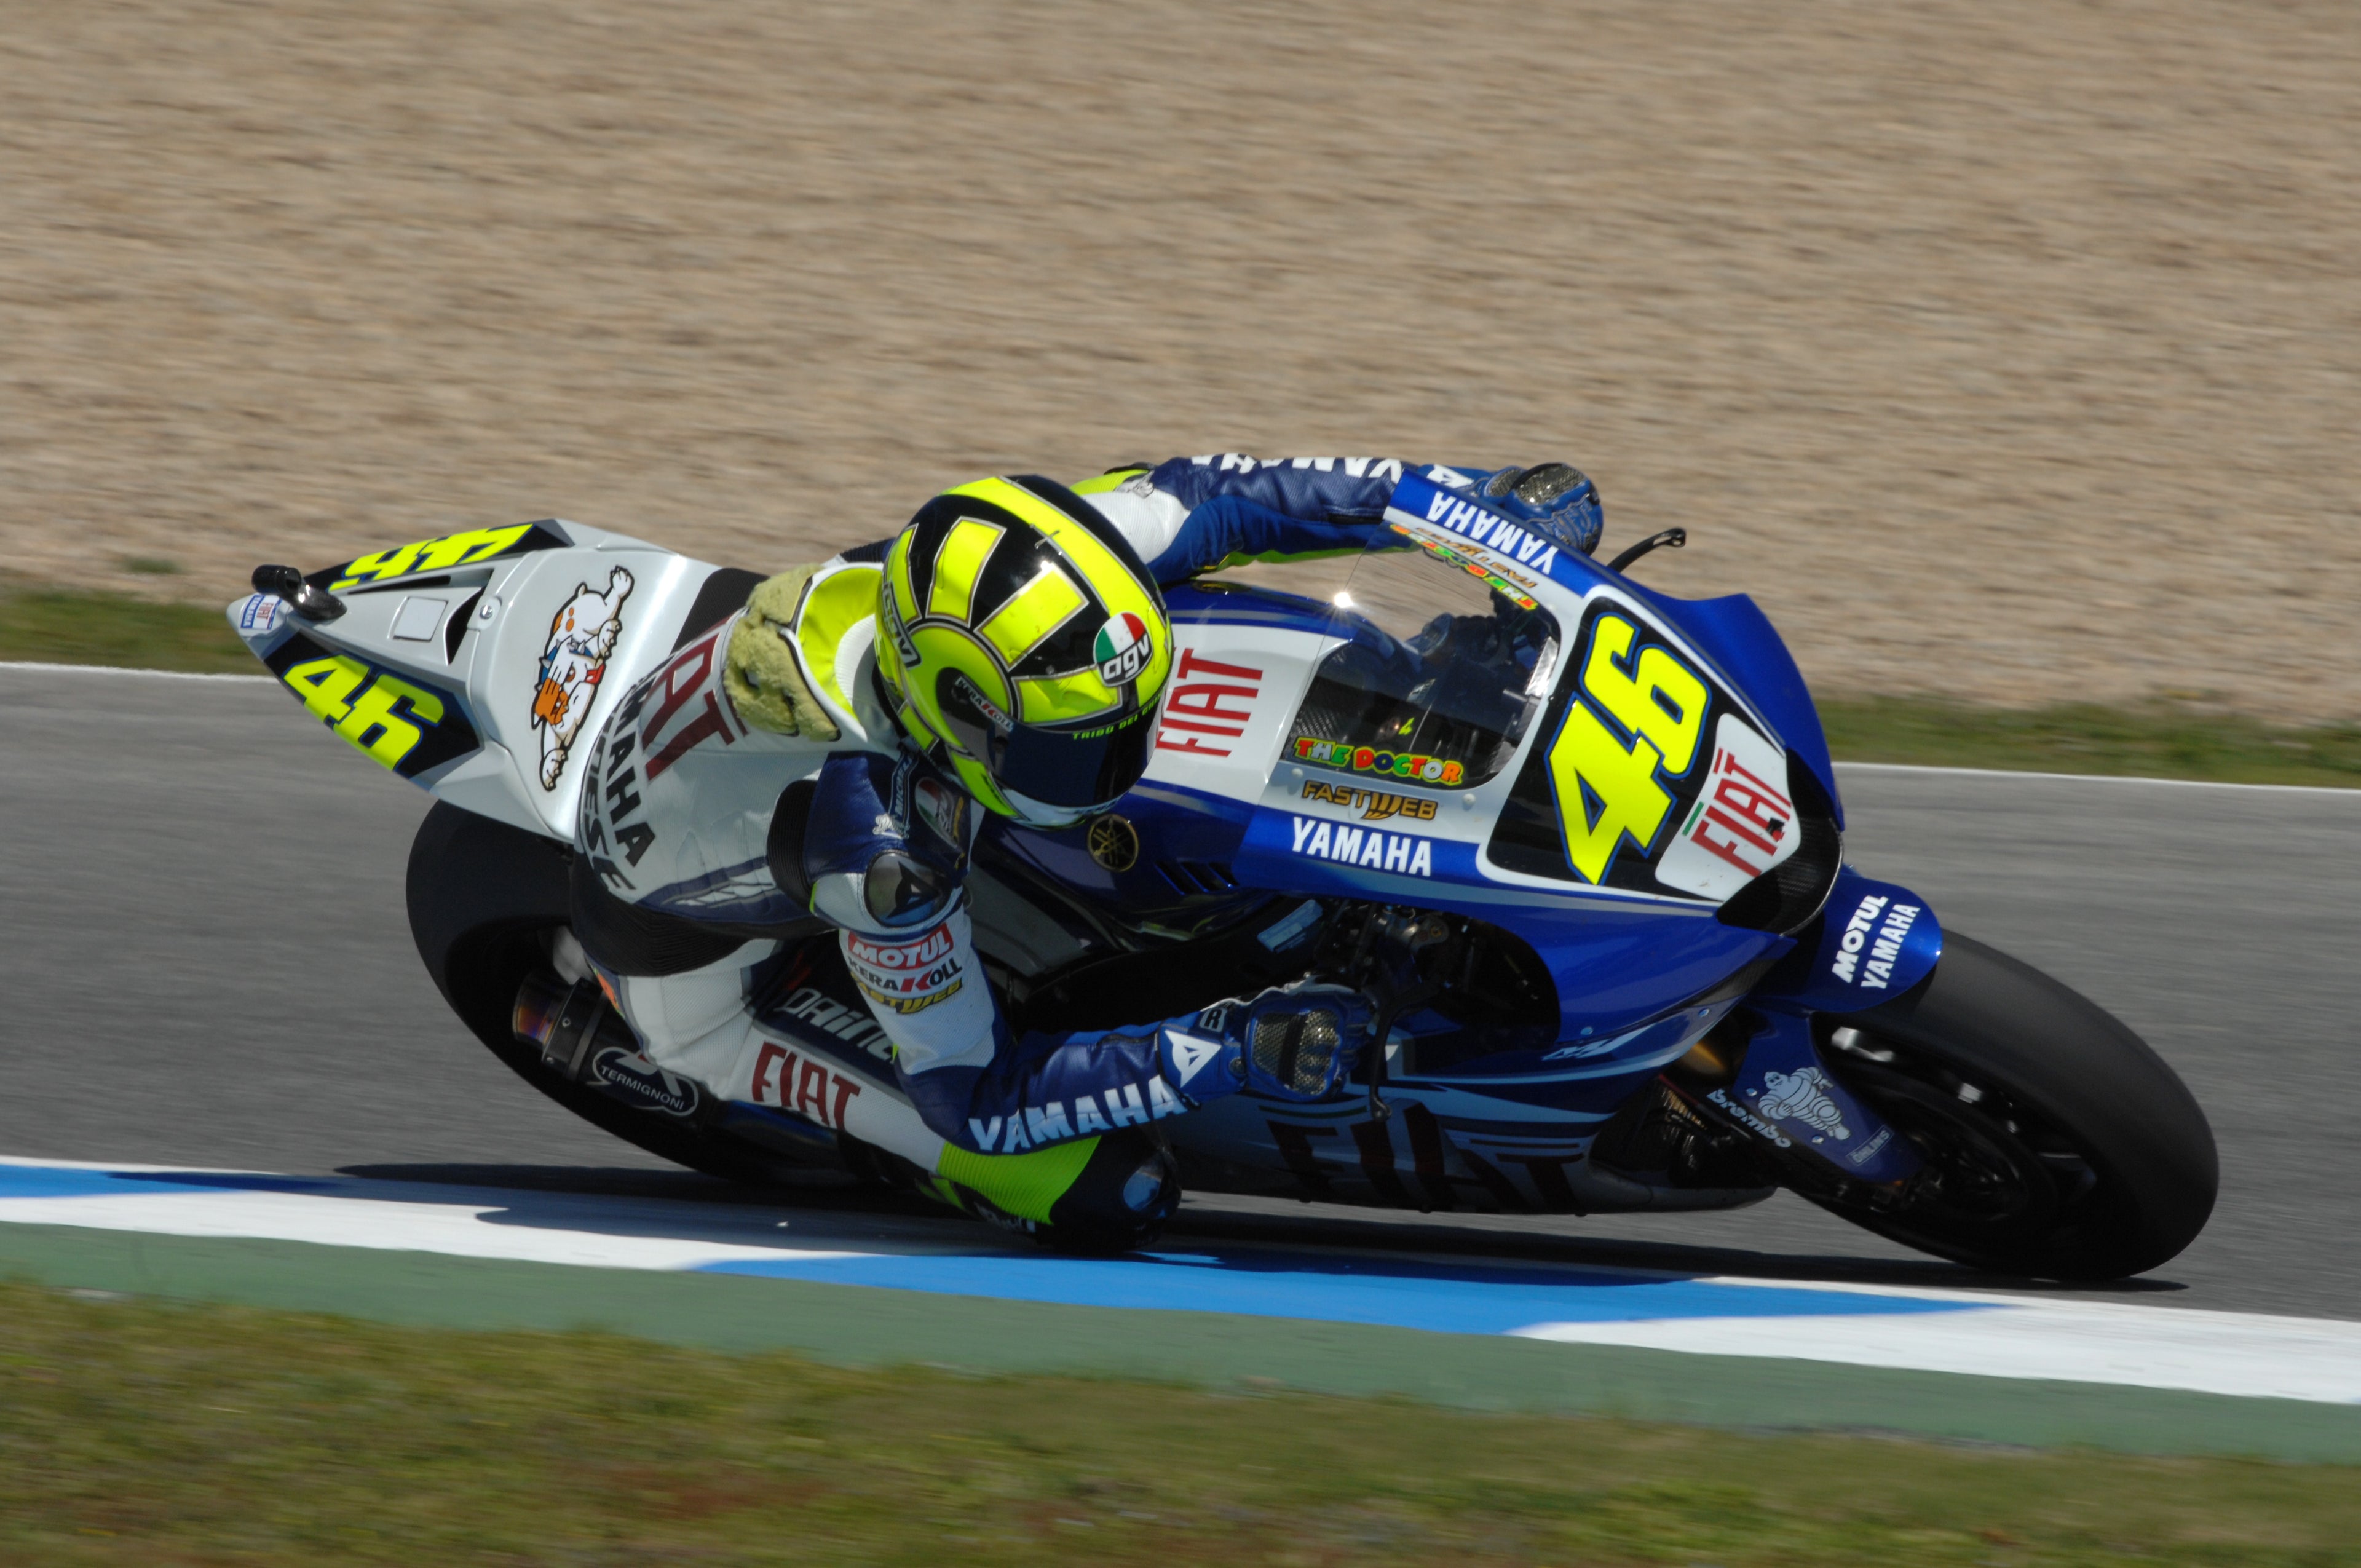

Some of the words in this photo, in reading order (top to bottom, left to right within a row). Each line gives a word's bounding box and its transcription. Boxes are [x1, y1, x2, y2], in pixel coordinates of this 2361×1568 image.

[1426, 491, 1557, 574] YAMAHA
[1483, 576, 1538, 611] THE
[283, 654, 445, 772] 46
[1155, 648, 1263, 757] FIAT
[1294, 736, 1354, 767] THE
[1353, 746, 1463, 785] DOCTOR
[1544, 611, 1712, 886] 46
[1301, 779, 1438, 820] FASTWEB
[1691, 752, 1792, 877] FIAT
[1292, 816, 1431, 877] YAMAHA
[848, 957, 963, 992] KERAKOLL
[852, 931, 951, 968] MOTUL
[1832, 895, 1889, 983] MOTUL
[1861, 904, 1921, 989] YAMAHA
[600, 1065, 684, 1111] TERMIGNONI
[752, 1042, 861, 1130] FIAT
[968, 1074, 1188, 1153] YAMAHA
[1706, 1088, 1792, 1148] brembo
[1265, 1103, 1584, 1211] FIAT
